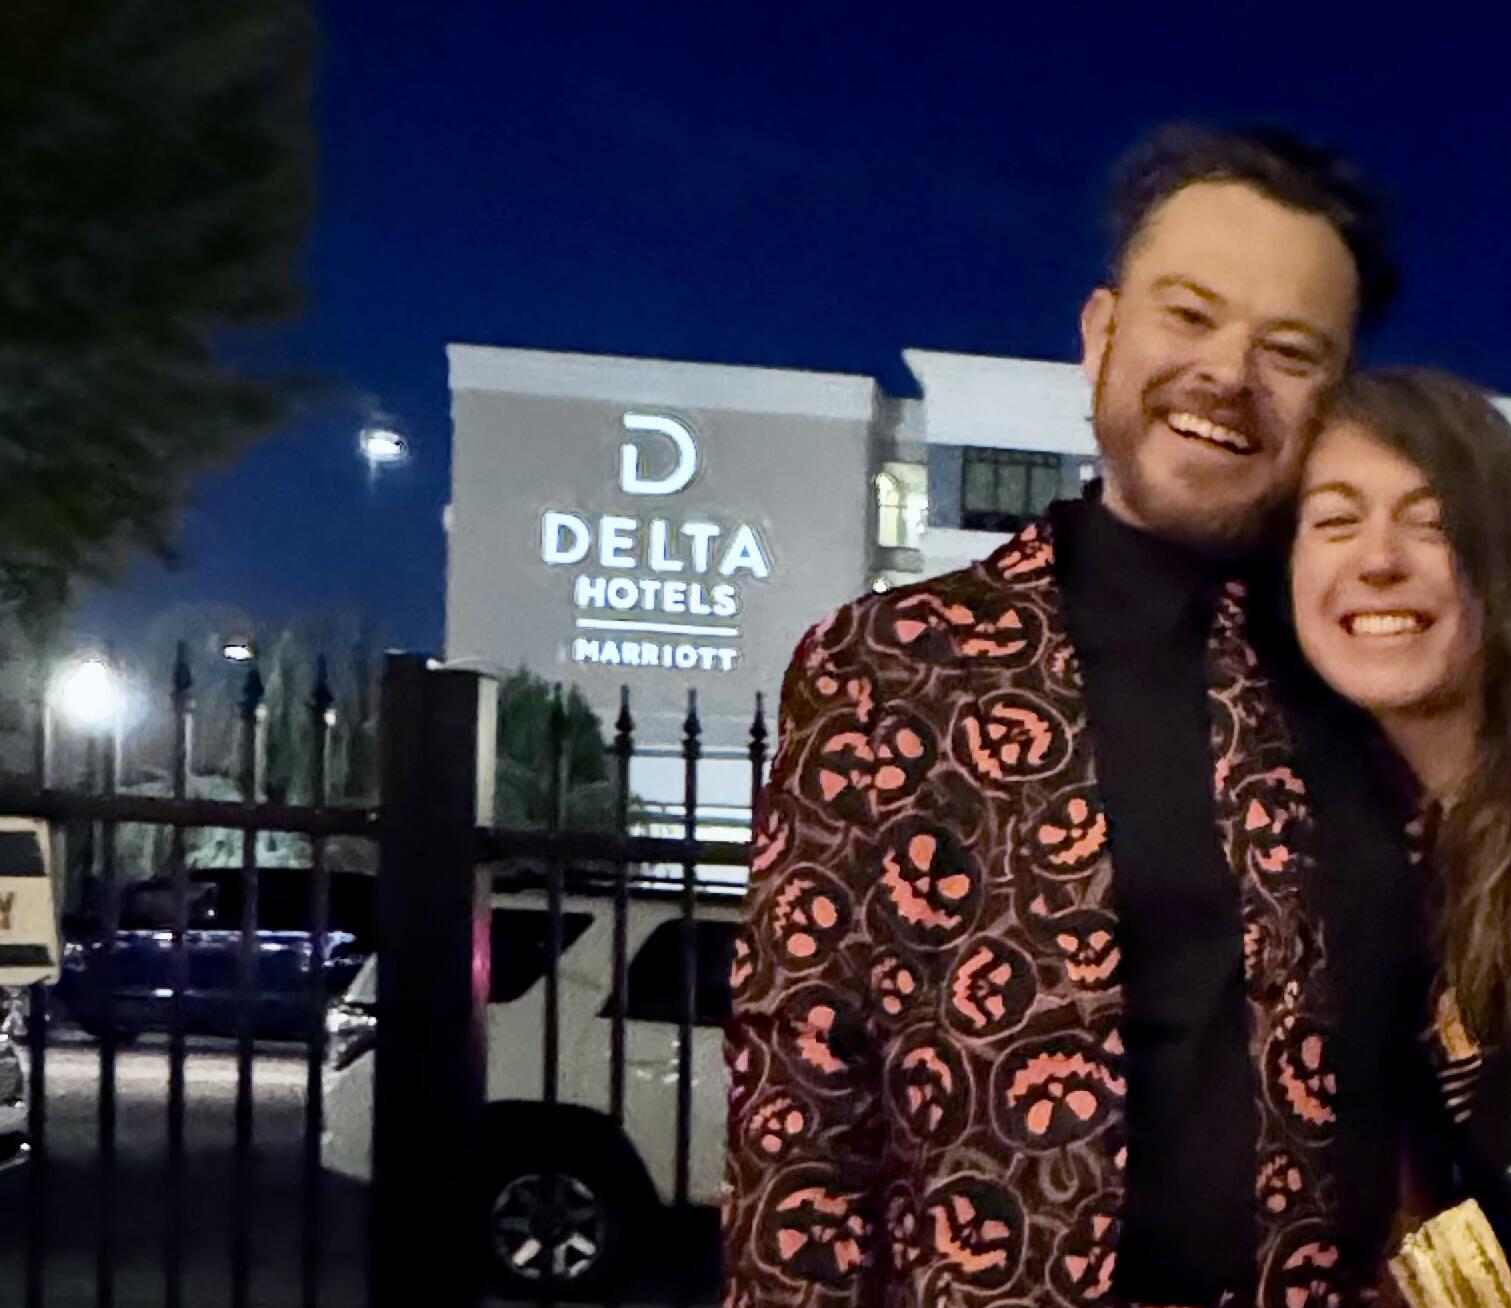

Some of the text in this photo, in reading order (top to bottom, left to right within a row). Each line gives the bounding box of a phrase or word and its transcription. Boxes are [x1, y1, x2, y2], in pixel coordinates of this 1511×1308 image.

[541, 511, 770, 577] DELTA
[575, 576, 738, 615] HOTELS
[574, 638, 737, 671] MARRIOTT
